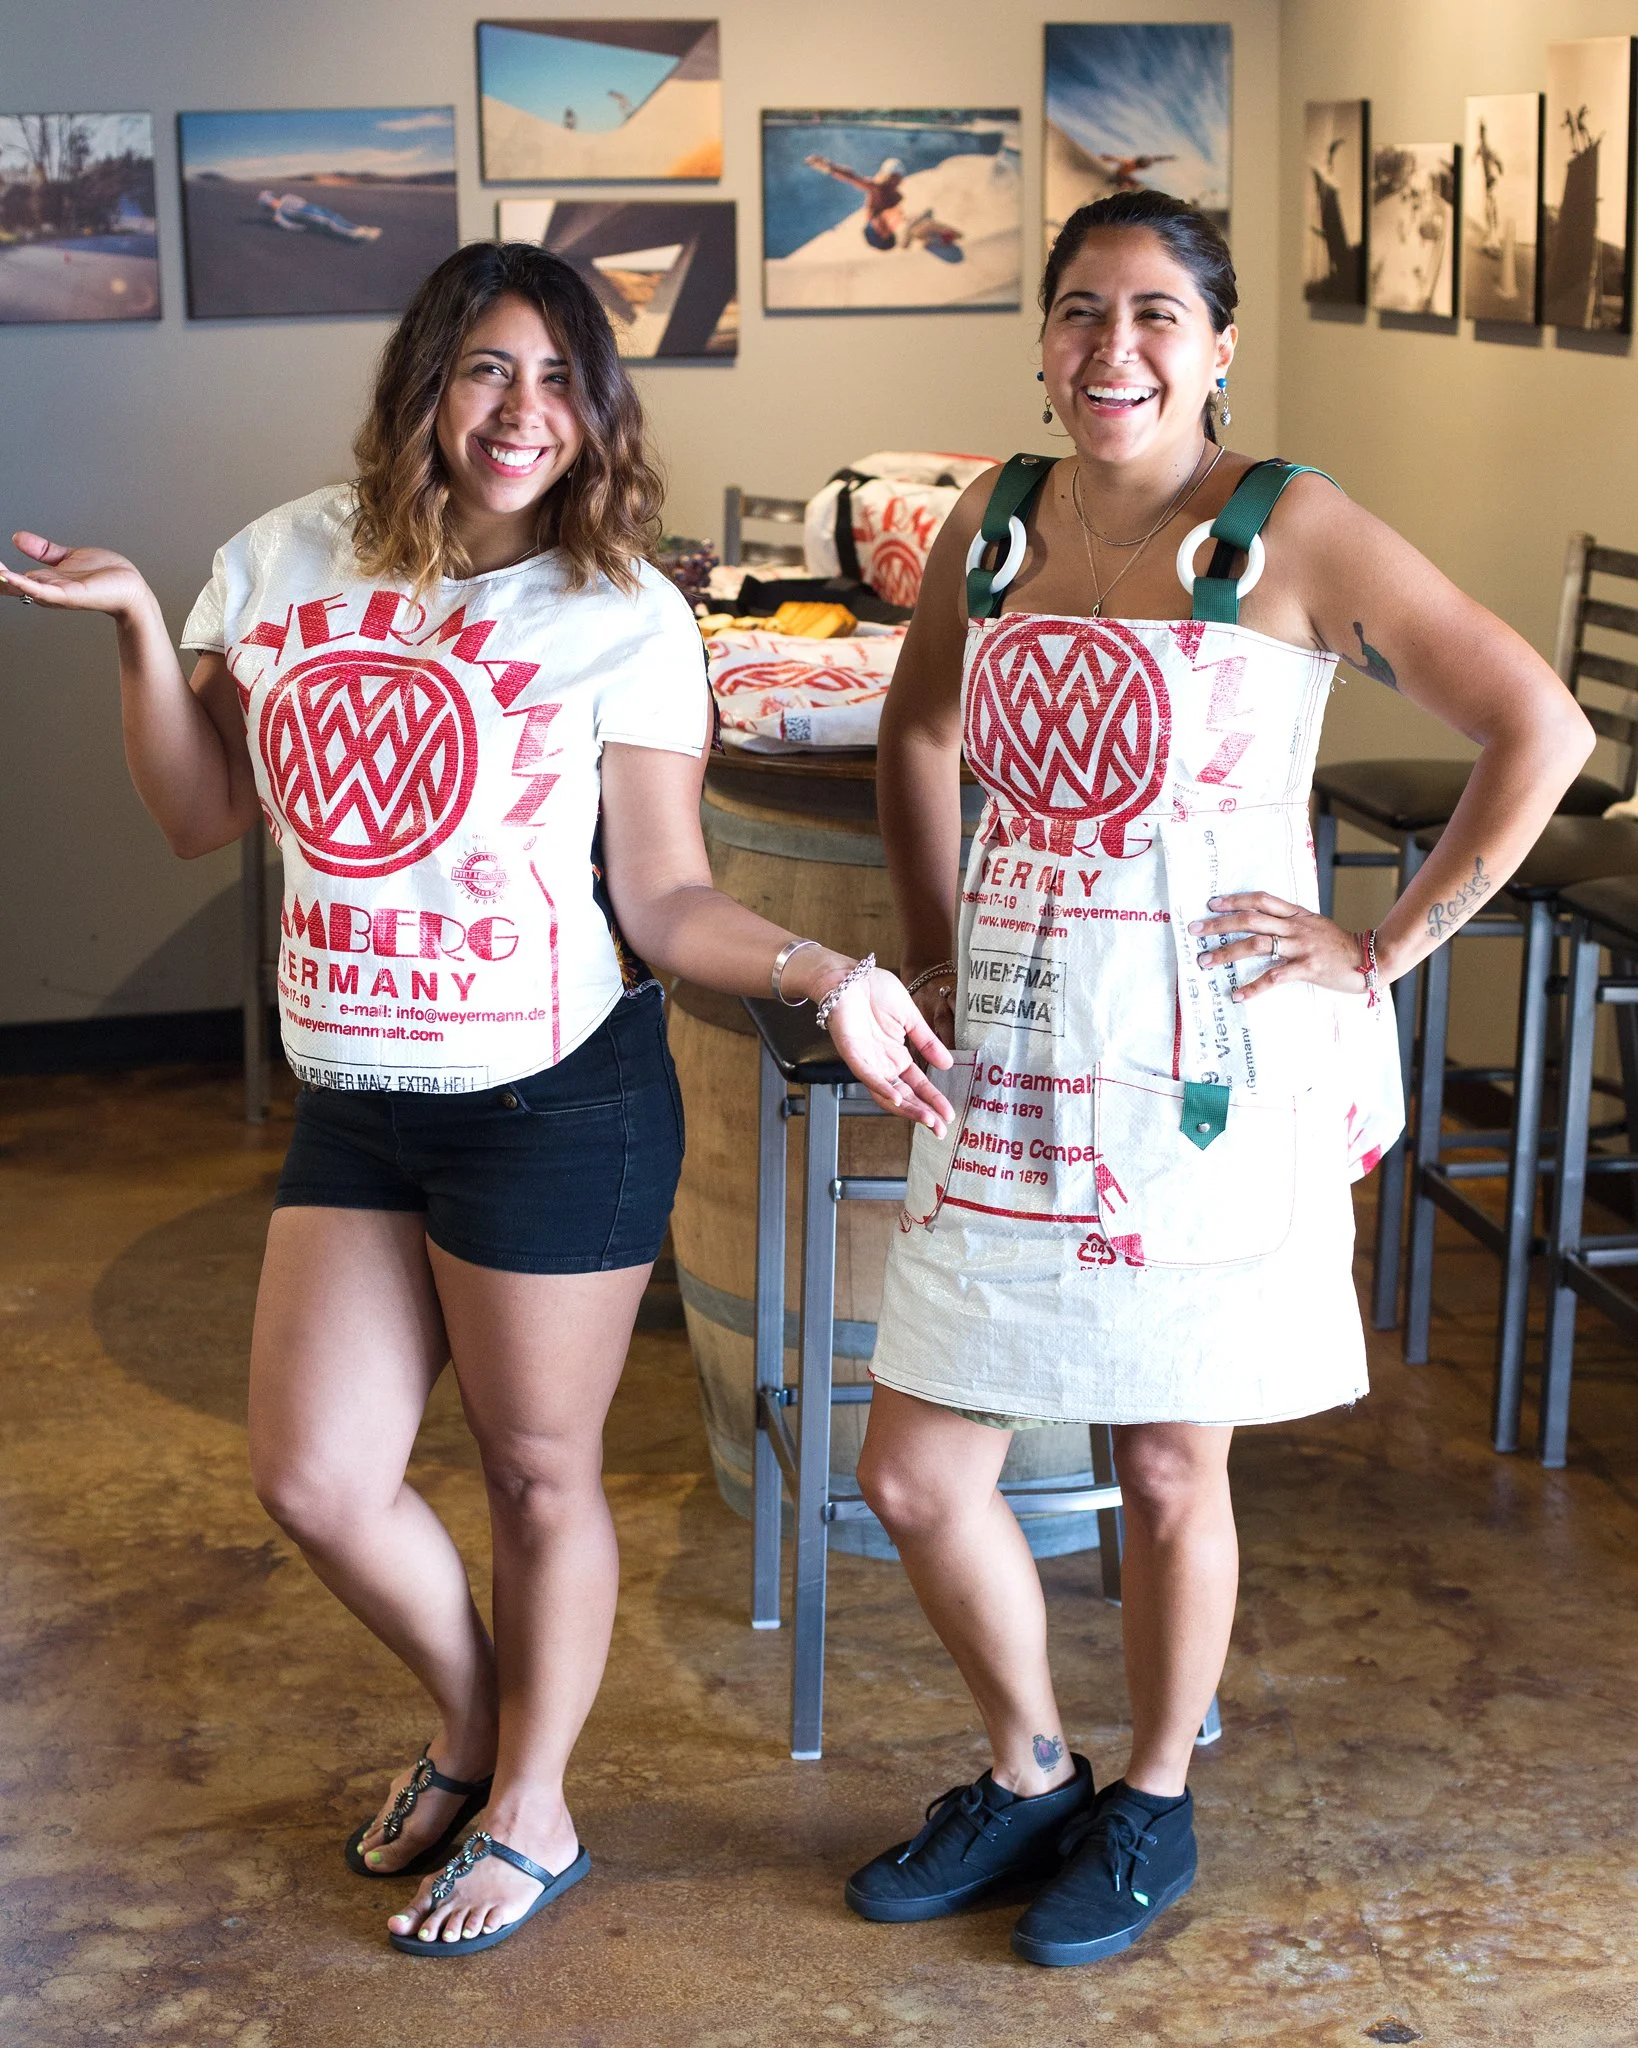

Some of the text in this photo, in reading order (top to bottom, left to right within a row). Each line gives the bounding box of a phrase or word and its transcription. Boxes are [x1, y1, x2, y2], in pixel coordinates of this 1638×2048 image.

[339, 1003, 392, 1018] e-mail:
[396, 1006, 547, 1025] info@weyermann.de
[1241, 1027, 1256, 1089] Germany
[310, 1066, 354, 1092] PILSNER
[357, 1073, 392, 1092] MALZ
[399, 1075, 440, 1093] EXTRA
[1011, 1102, 1043, 1119] 1879
[1001, 1166, 1014, 1181] in
[1019, 1170, 1049, 1186] 1879
